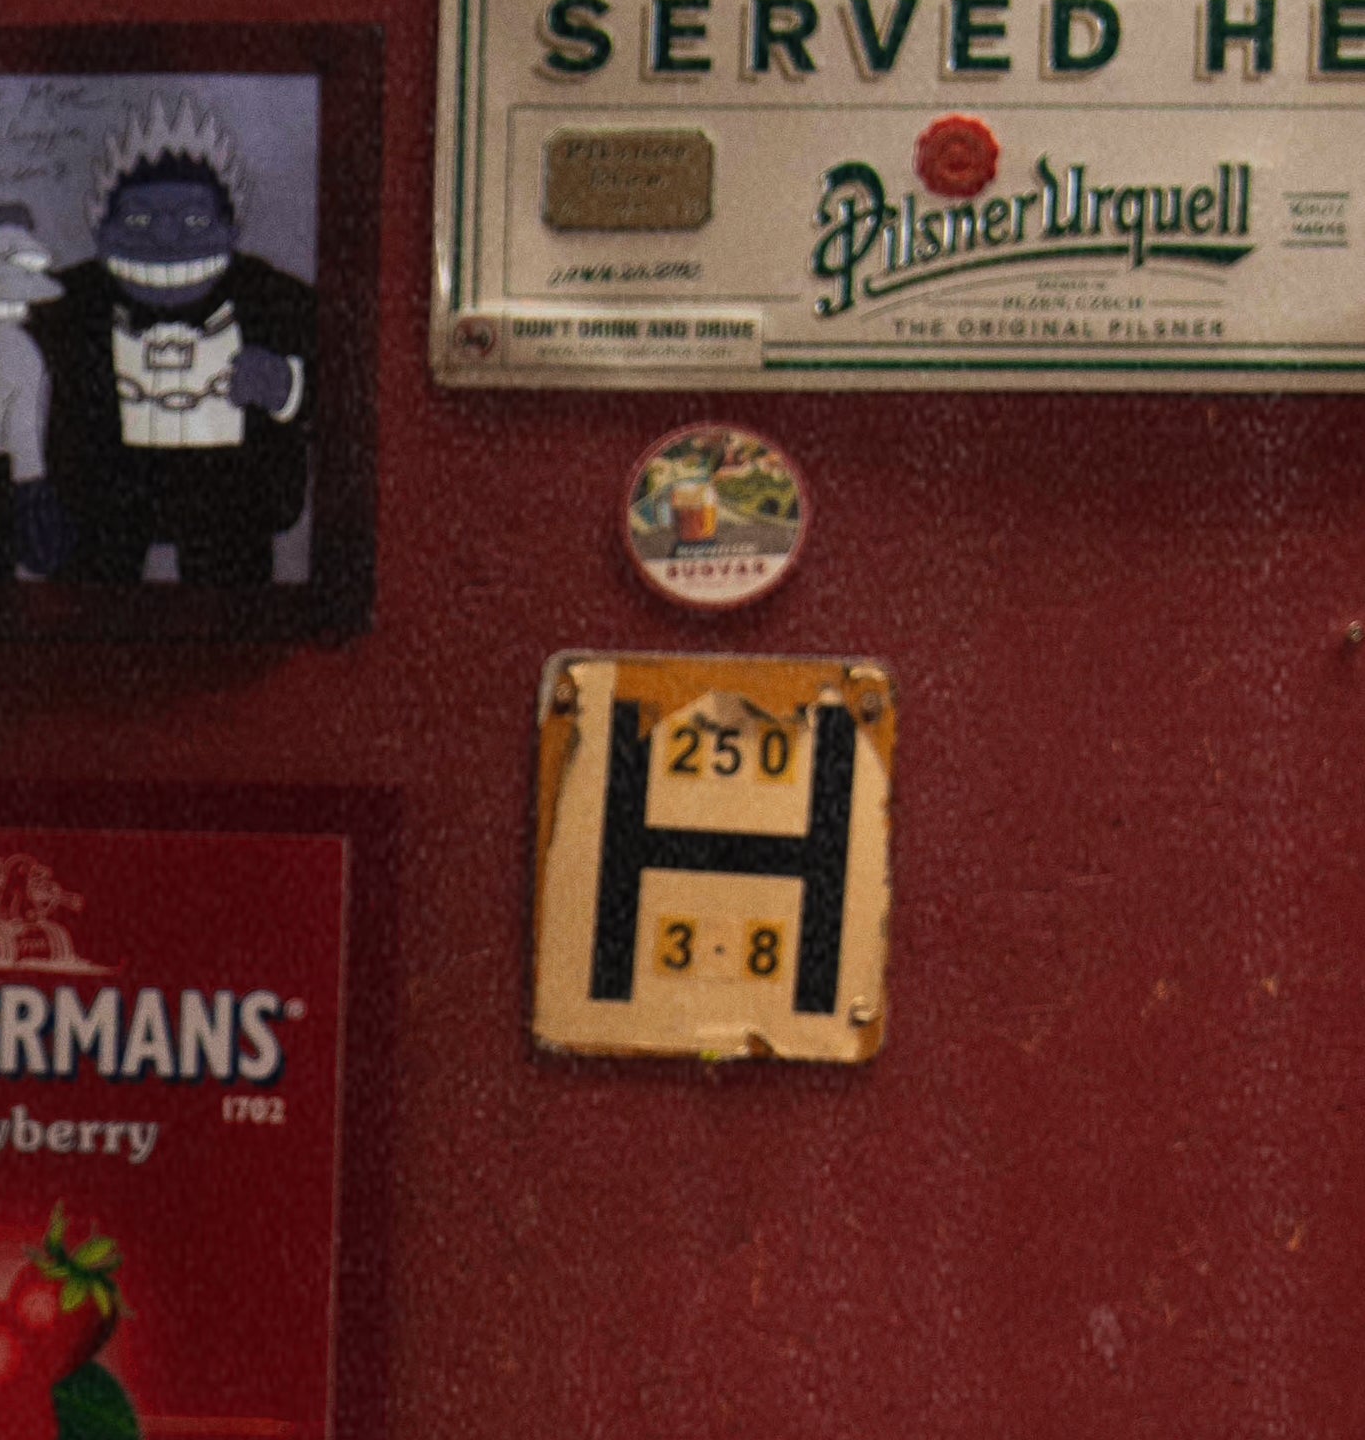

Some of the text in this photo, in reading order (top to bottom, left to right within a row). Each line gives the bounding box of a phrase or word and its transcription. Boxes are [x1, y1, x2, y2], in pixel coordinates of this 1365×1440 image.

[812, 152, 1254, 319] Pilsner Urquell
[893, 318, 1225, 340] THE ORIGINAL PILSNER
[671, 727, 789, 776] 250
[589, 699, 857, 1016] H
